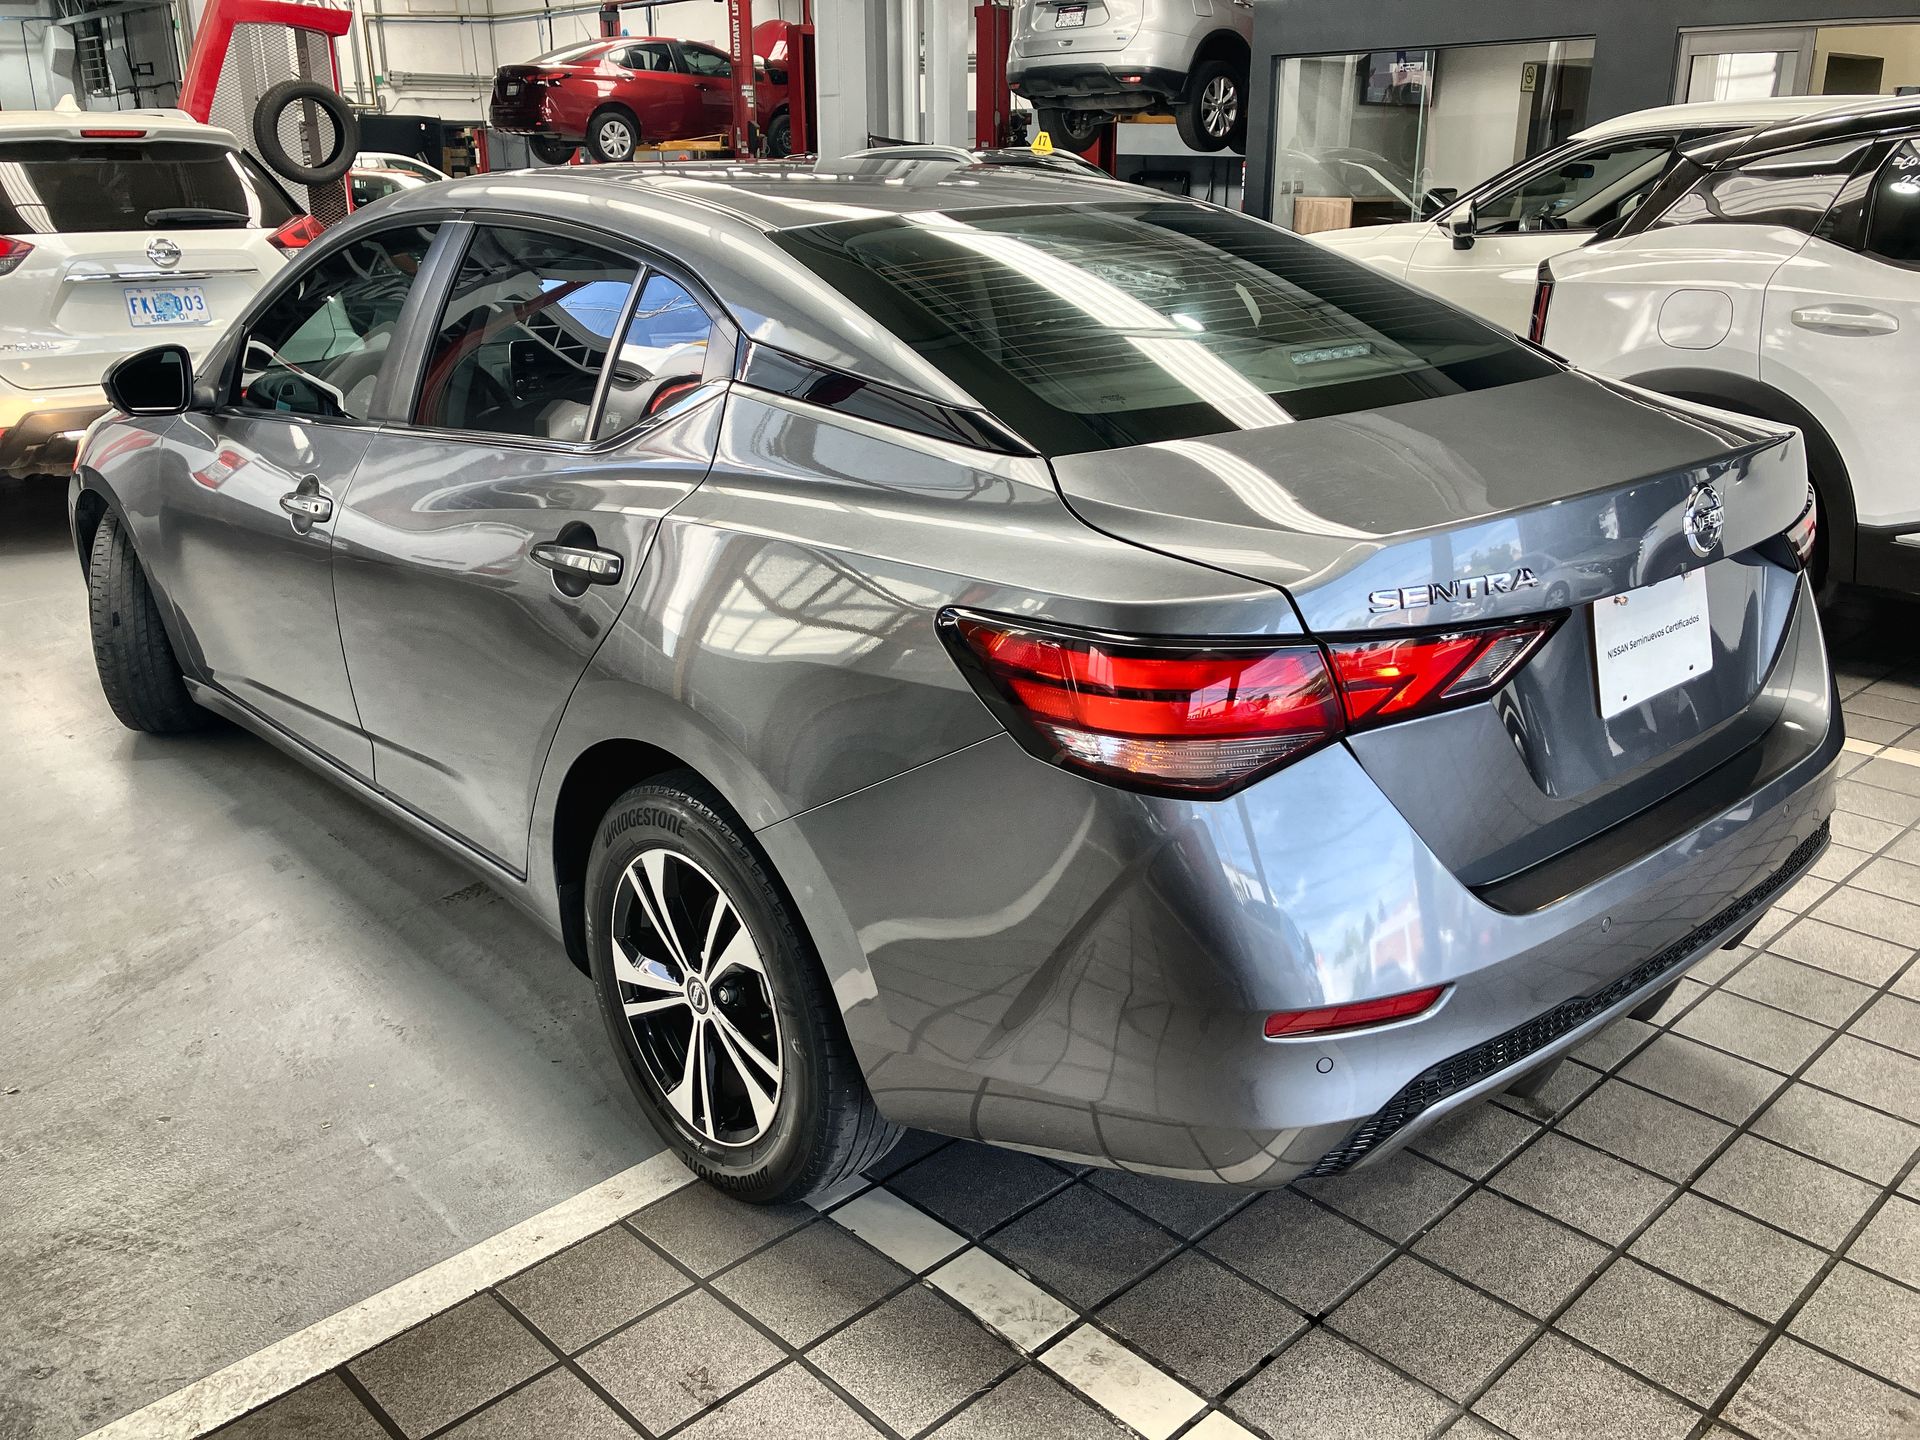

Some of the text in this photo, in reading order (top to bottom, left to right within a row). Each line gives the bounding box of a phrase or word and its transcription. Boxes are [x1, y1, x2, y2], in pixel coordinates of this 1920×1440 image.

[731, 0, 739, 16] LIF
[1038, 135, 1048, 147] 17
[1368, 567, 1539, 614] SENTRA
[1607, 614, 1700, 660] NISSAN Seminuevos Certificados
[603, 807, 687, 849] BRIDGESTONE
